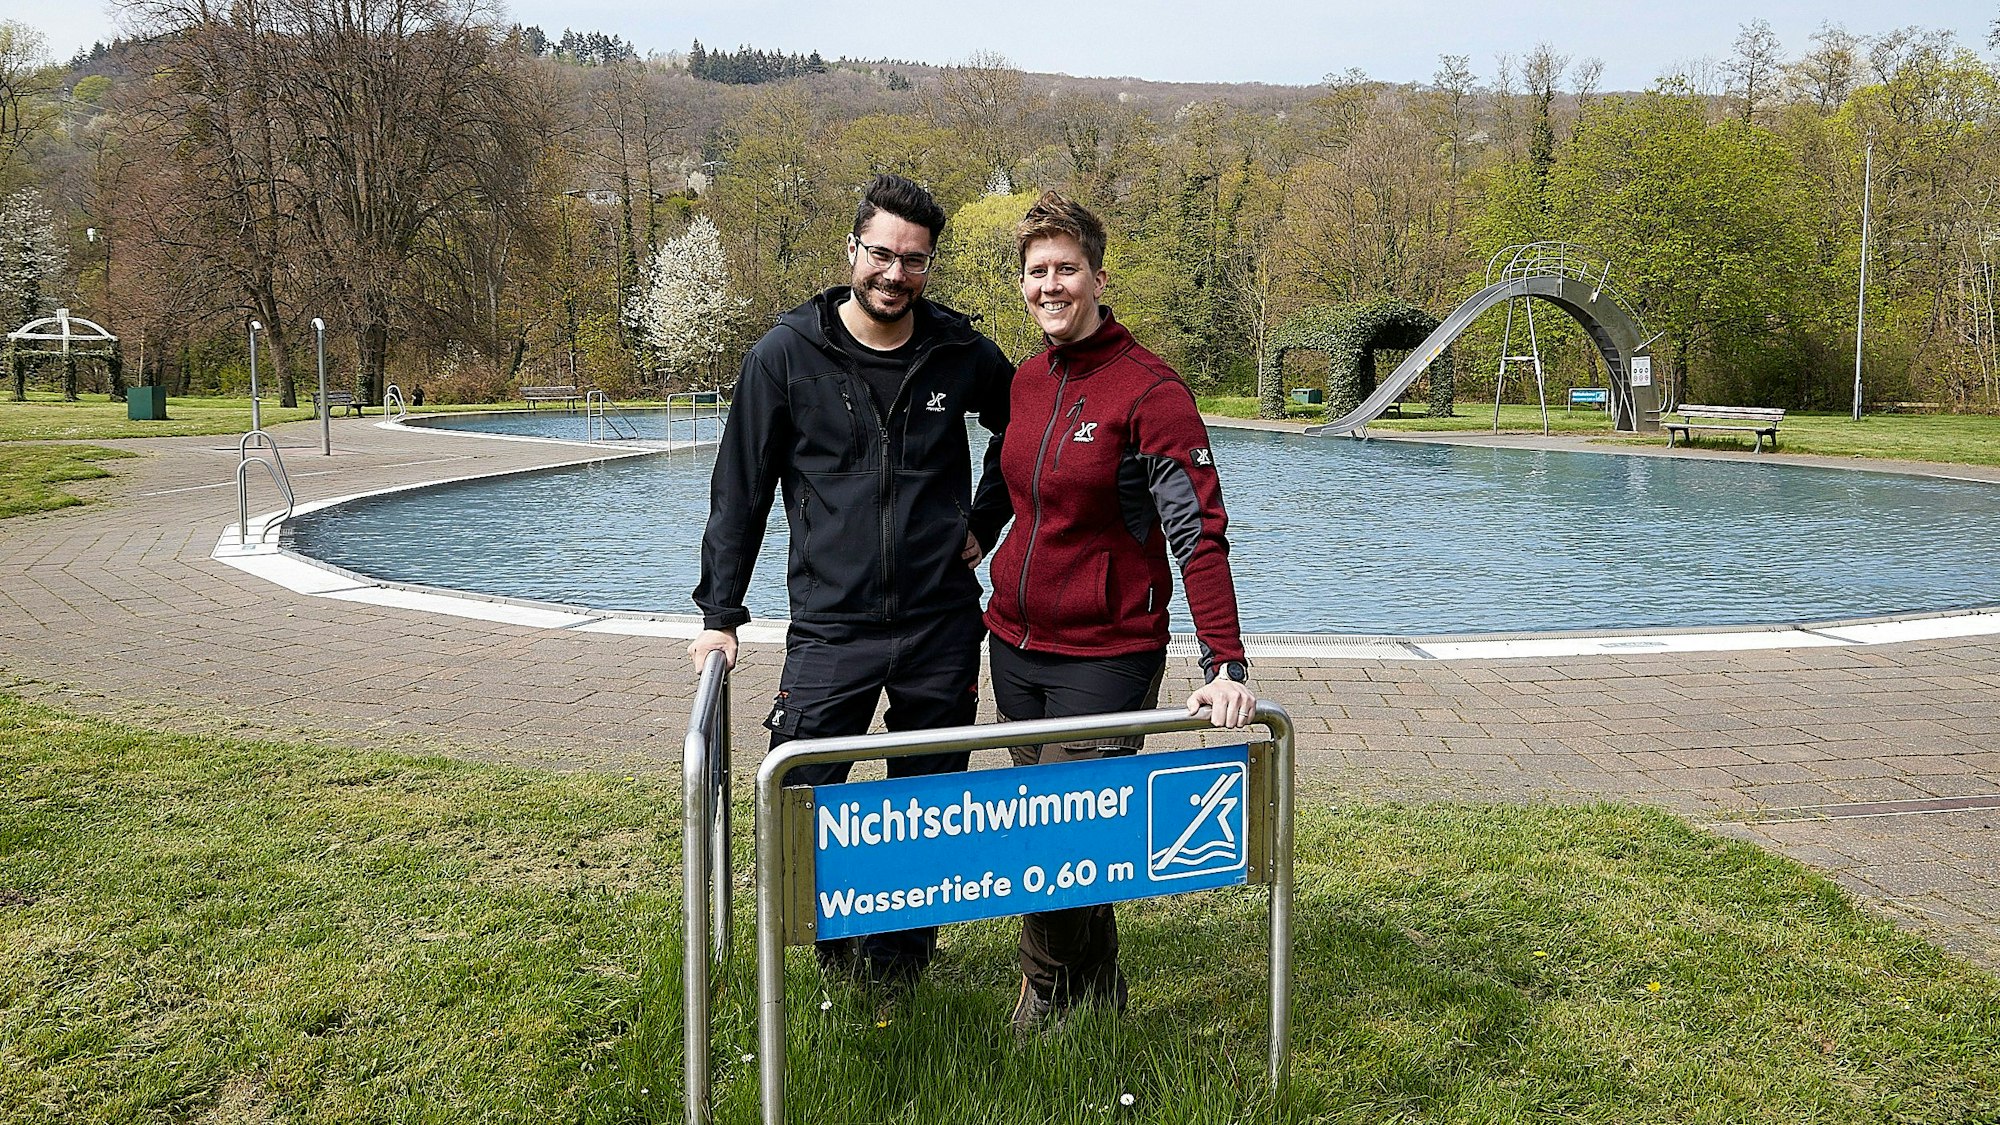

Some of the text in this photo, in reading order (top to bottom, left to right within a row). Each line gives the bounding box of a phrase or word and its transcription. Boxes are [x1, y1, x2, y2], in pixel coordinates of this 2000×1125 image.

[818, 784, 1134, 850] Nichtschwimmer
[819, 859, 1134, 919] Wassertiefe 0,60 m
